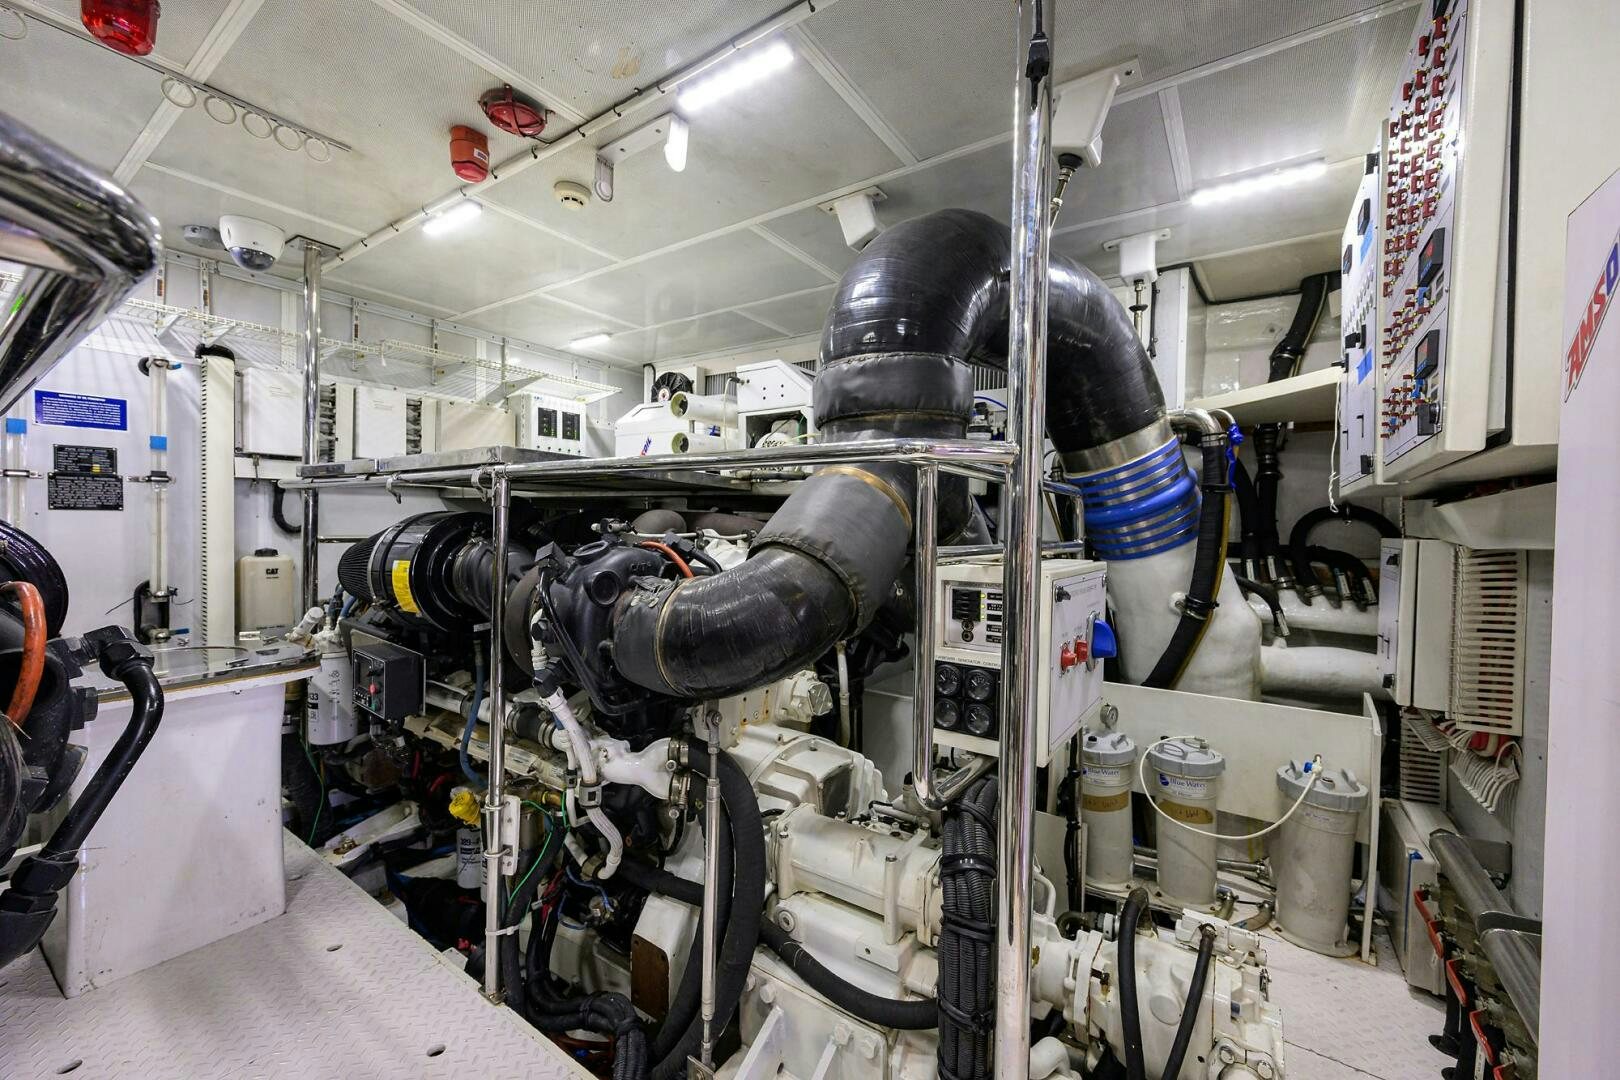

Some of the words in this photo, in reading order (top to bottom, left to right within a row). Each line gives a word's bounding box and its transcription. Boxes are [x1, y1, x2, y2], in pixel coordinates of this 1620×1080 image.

[1568, 241, 1619, 391] AMSO
[1170, 777, 1185, 787] Blue
[1185, 780, 1206, 789] Water
